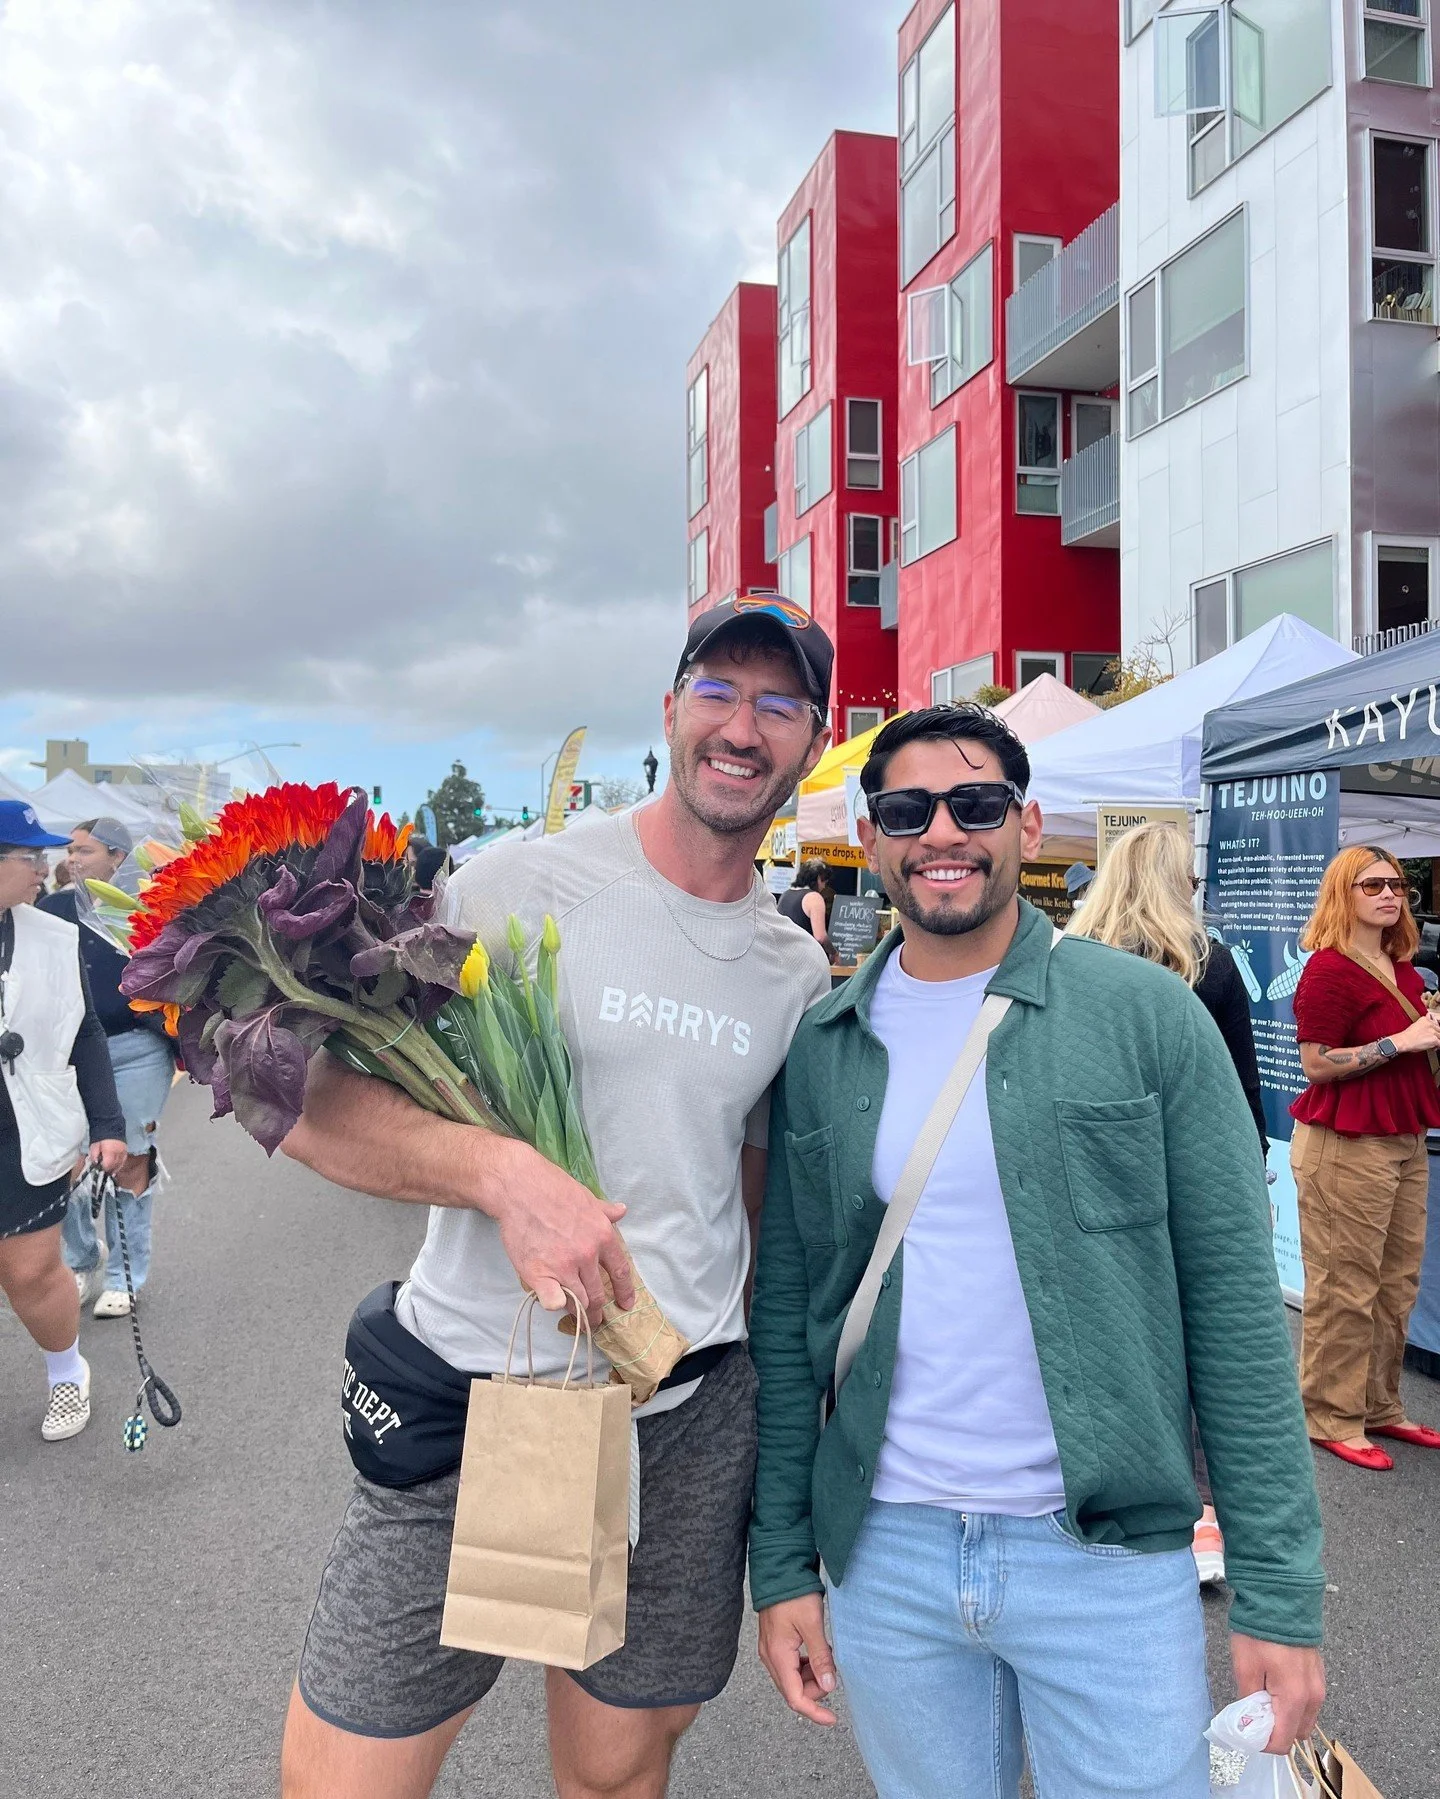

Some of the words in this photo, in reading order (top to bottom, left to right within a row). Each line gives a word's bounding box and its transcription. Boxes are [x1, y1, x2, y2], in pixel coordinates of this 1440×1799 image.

[1219, 772, 1327, 808] TEJUINO
[1251, 807, 1324, 820] TEH-HOO-UEEN-OH
[1219, 840, 1239, 850] WHAT
[1248, 838, 1260, 848] IT?
[832, 845, 857, 861] drops,
[1302, 854, 1325, 862] beverage
[1267, 866, 1287, 874] variety
[1020, 871, 1051, 888] Gourmet
[1296, 889, 1305, 899] gut
[839, 904, 875, 923] FLAVORS
[1268, 924, 1280, 932] and
[1280, 924, 1299, 933] winter
[599, 986, 752, 1057] BARRY'S
[1275, 1058, 1287, 1067] and
[1270, 1069, 1290, 1079] Mexico
[1281, 1084, 1289, 1092] to
[351, 1381, 402, 1445] DEPT.
